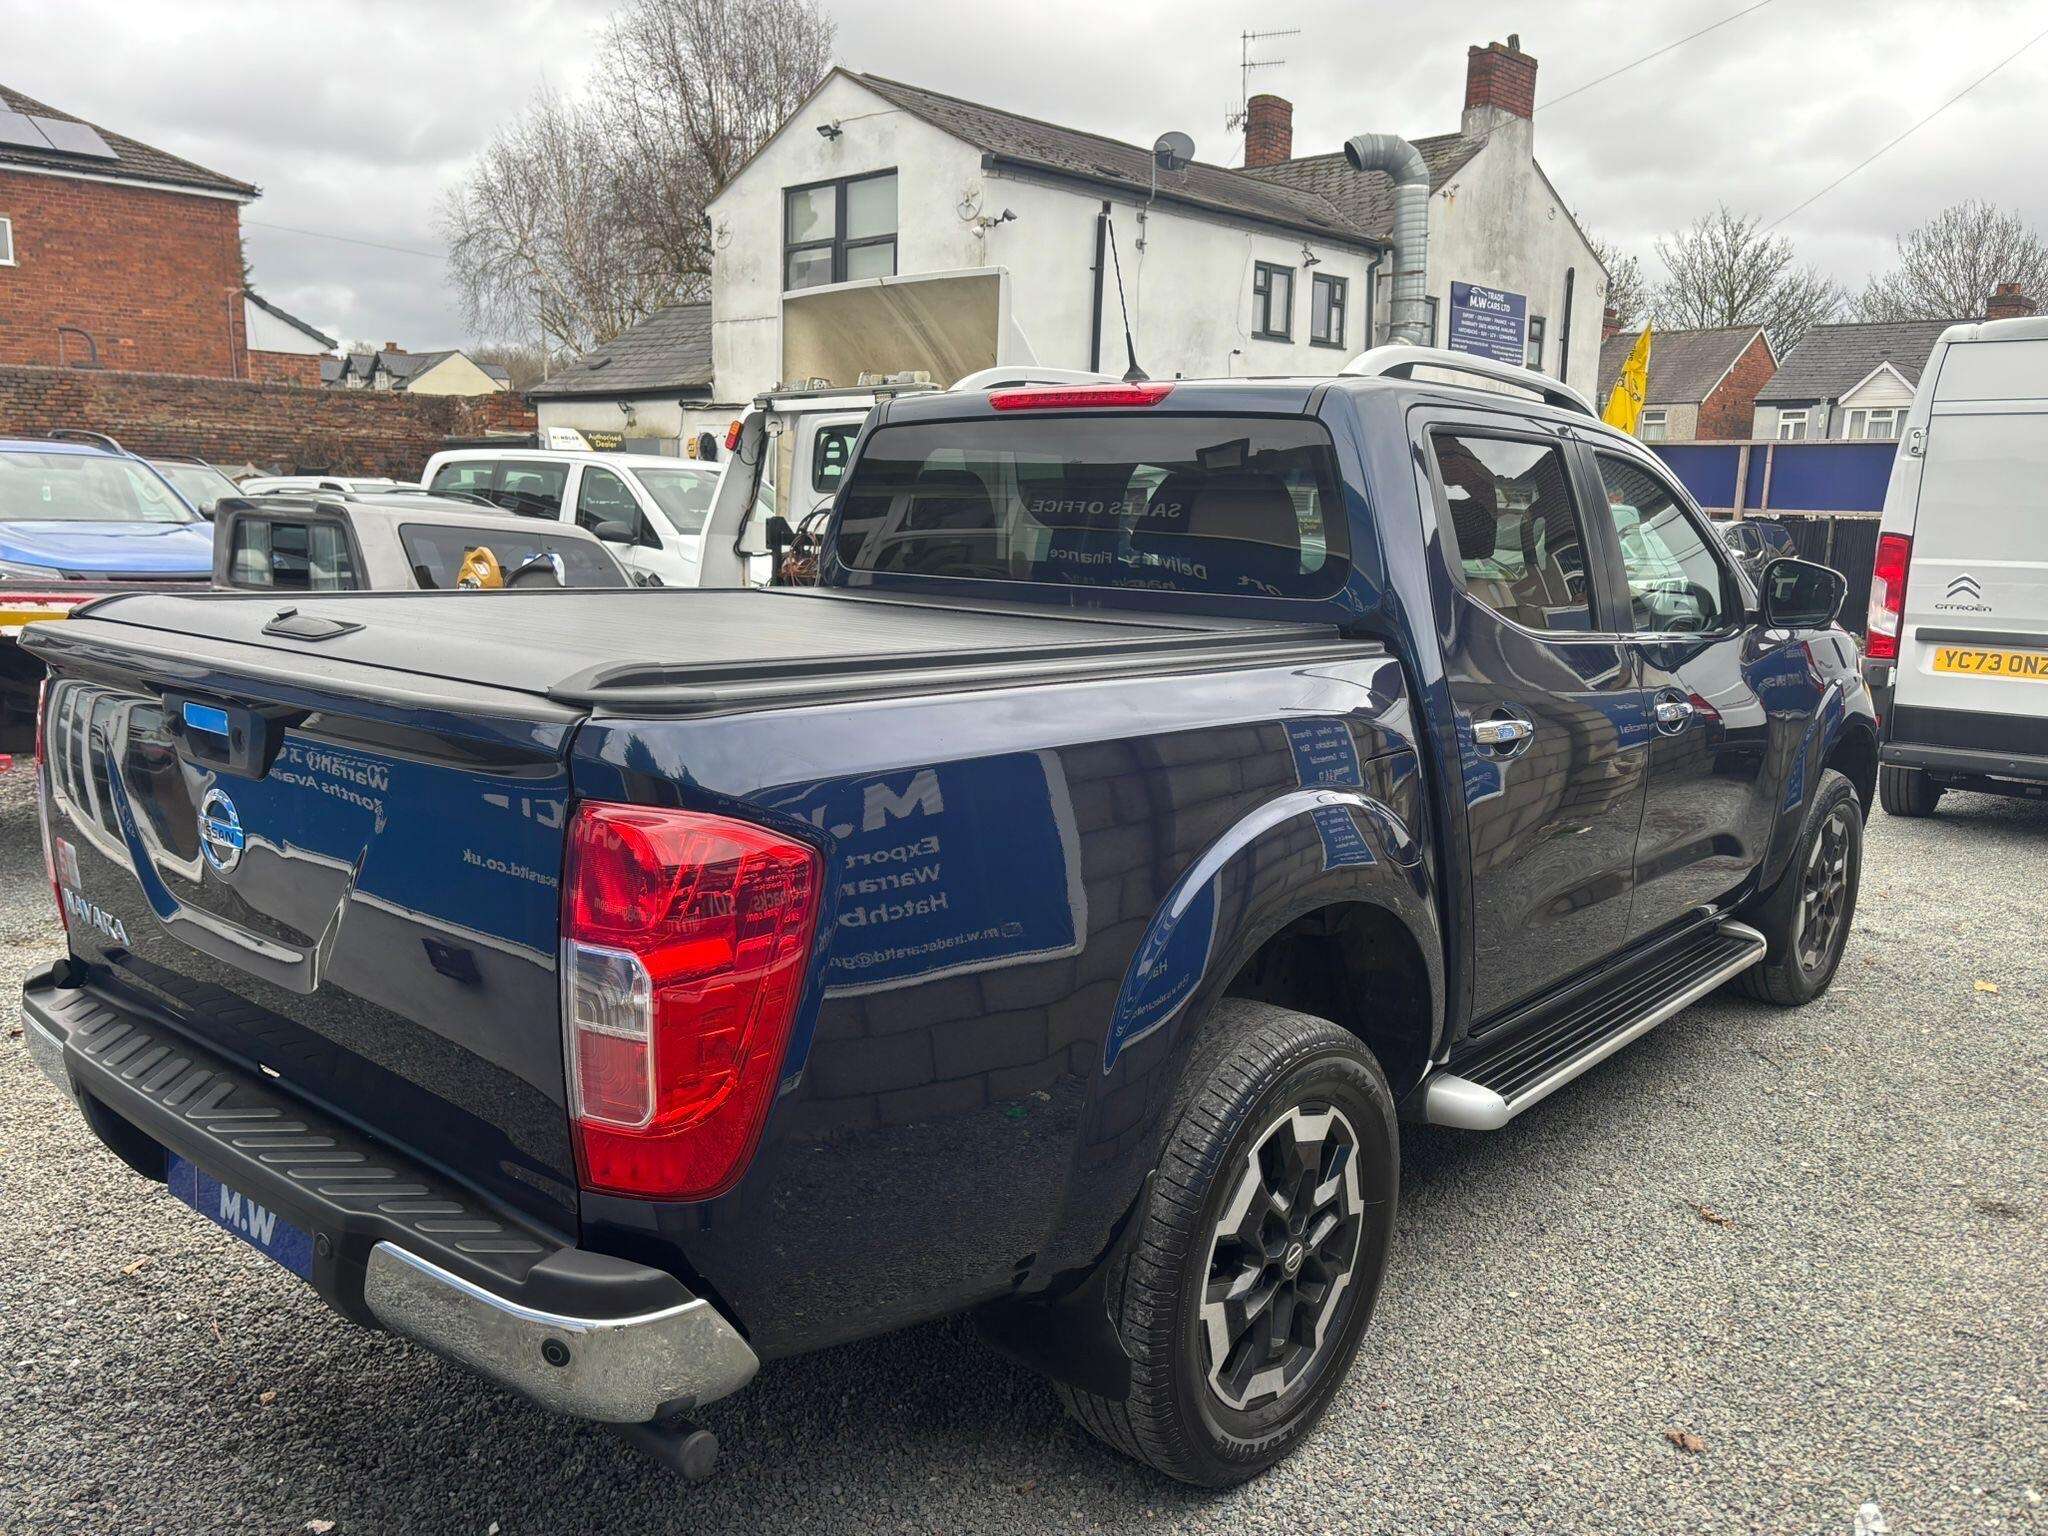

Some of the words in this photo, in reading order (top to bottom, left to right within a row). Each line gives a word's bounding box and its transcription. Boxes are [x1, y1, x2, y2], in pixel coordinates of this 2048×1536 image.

[1470, 295, 1487, 308] M.W
[1488, 292, 1504, 302] TRADE
[1487, 301, 1500, 310] CARS
[1501, 304, 1511, 313] LTD
[588, 432, 622, 443] Authorised
[596, 440, 617, 449] Dealer
[1934, 603, 1992, 613] CITROËN
[1945, 650, 2002, 671] YC73
[64, 888, 130, 946] NAVARA
[219, 1182, 278, 1247] M.W
